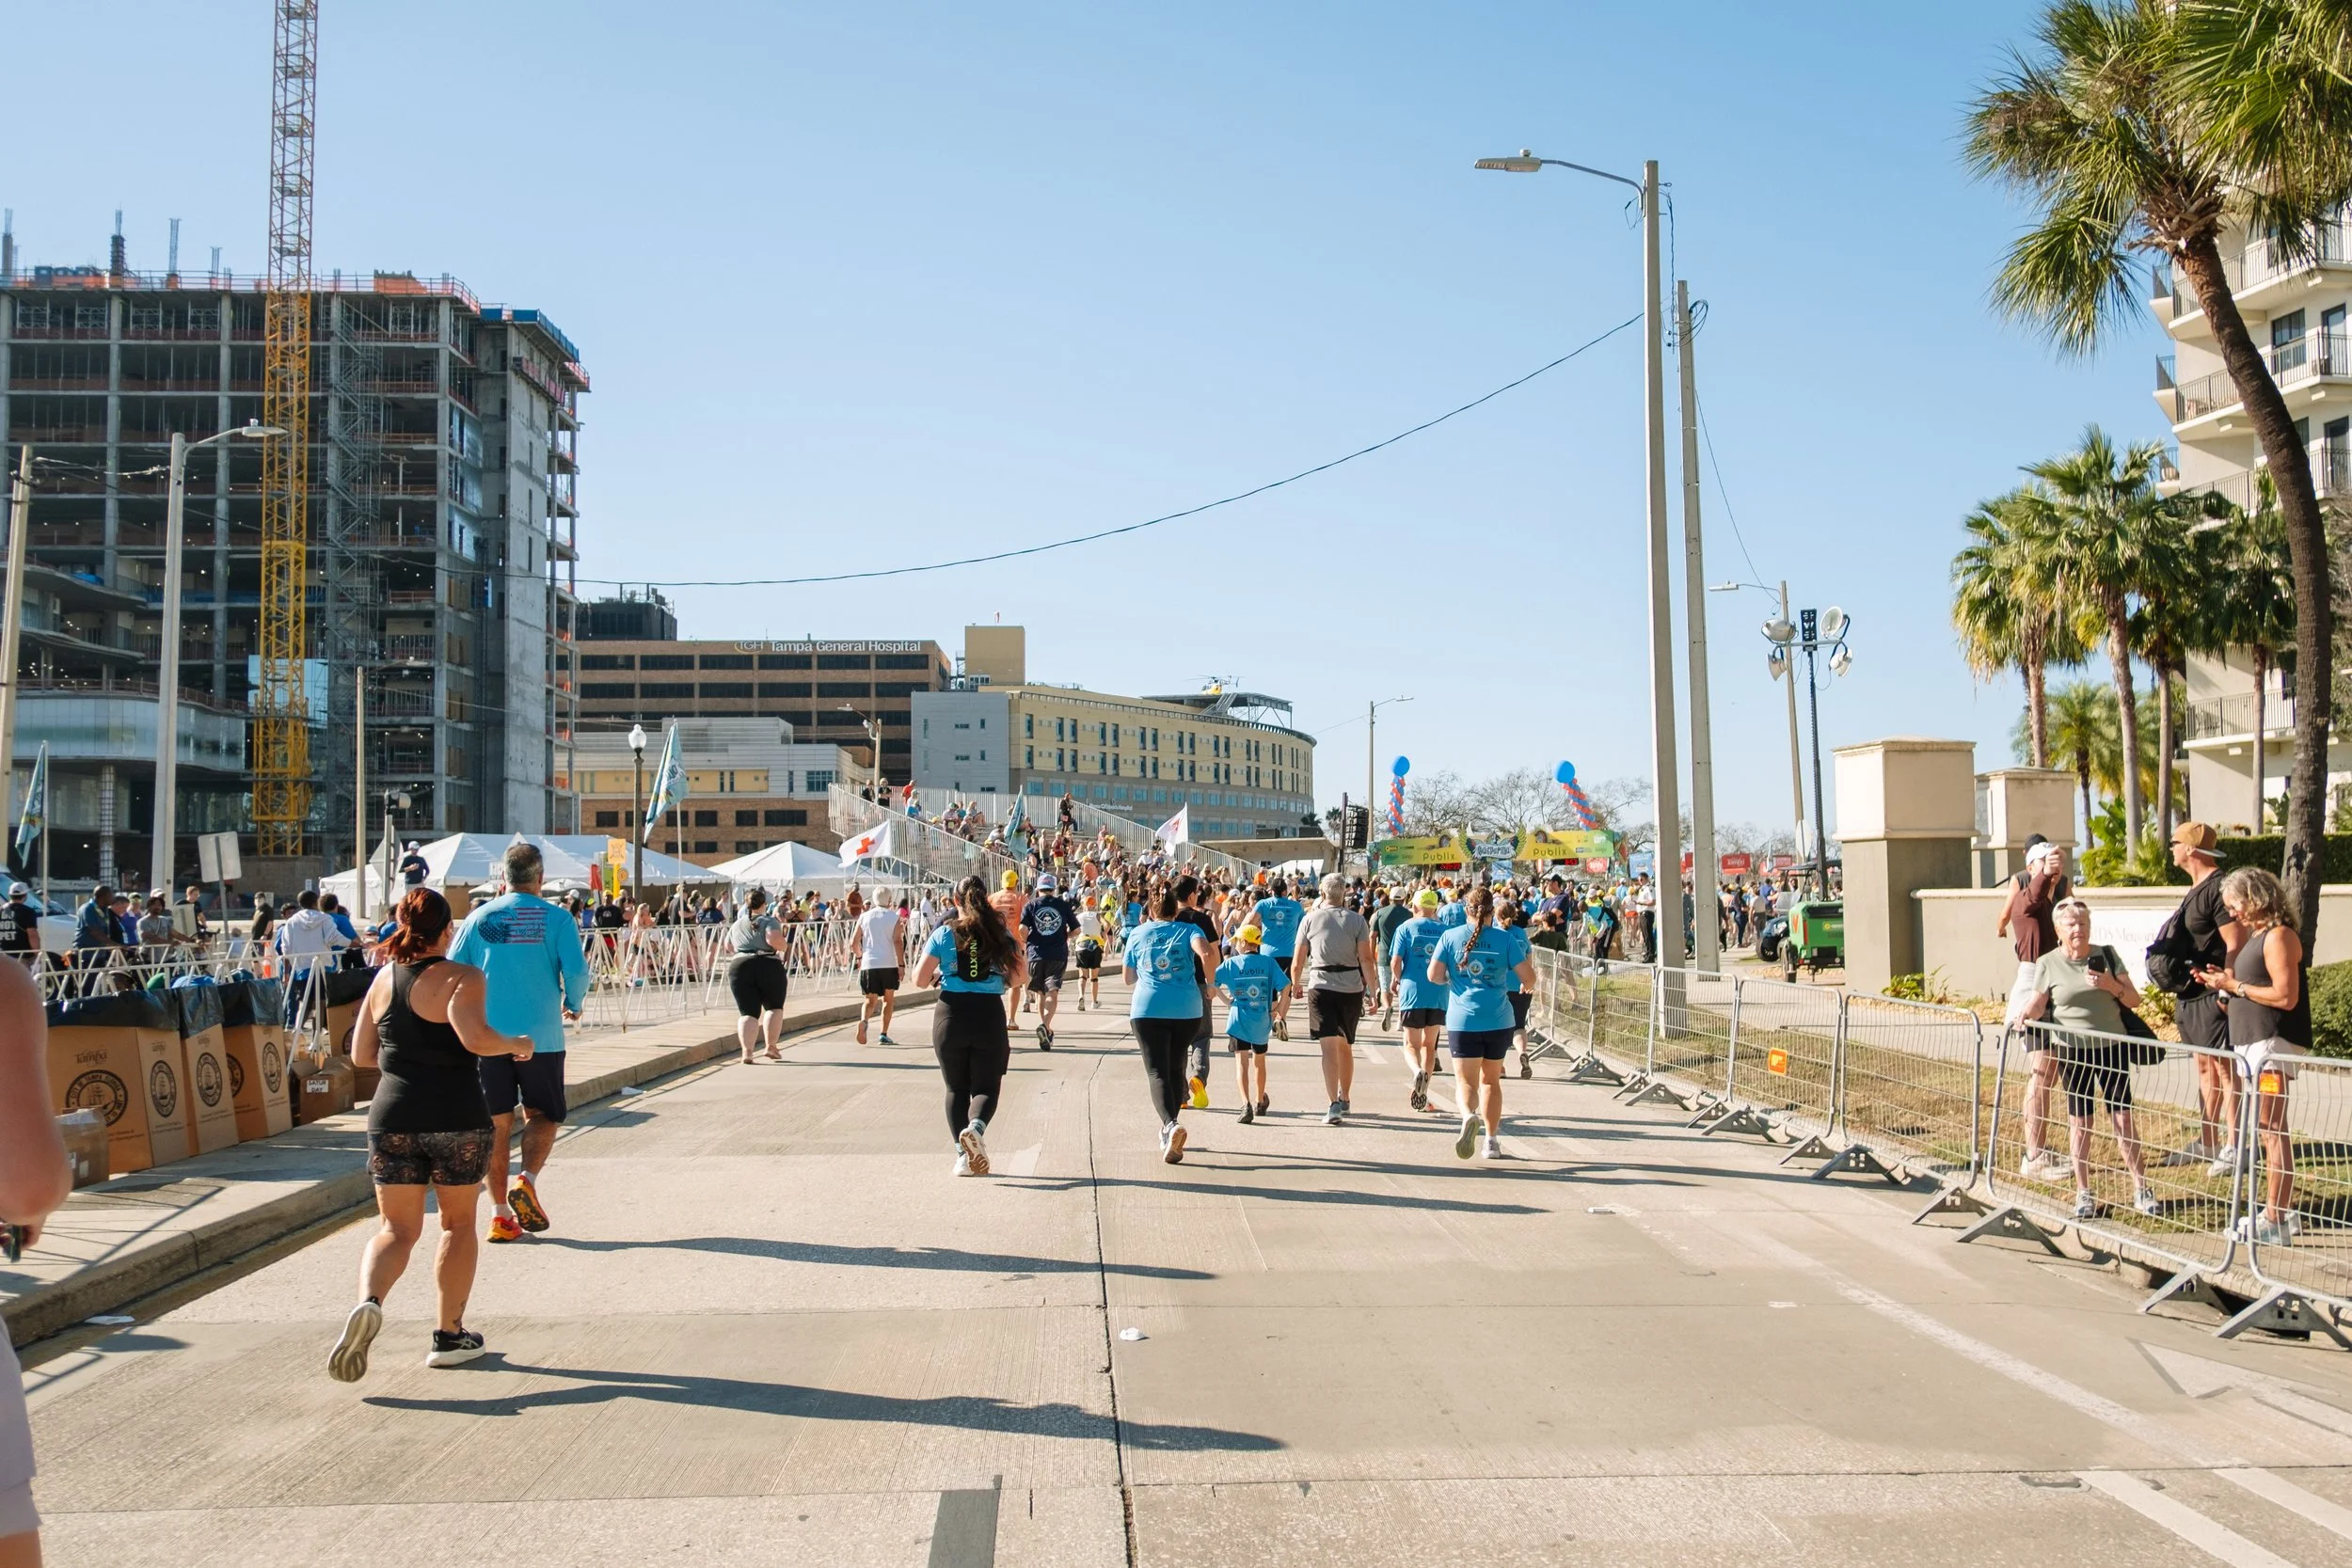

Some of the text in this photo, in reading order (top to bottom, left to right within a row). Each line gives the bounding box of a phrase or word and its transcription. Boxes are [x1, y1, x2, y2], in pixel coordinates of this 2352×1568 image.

[739, 640, 764, 650] TGH
[770, 640, 921, 654] Tampa General Hospital
[1533, 846, 1567, 857] Publix
[1422, 852, 1455, 862] Publix
